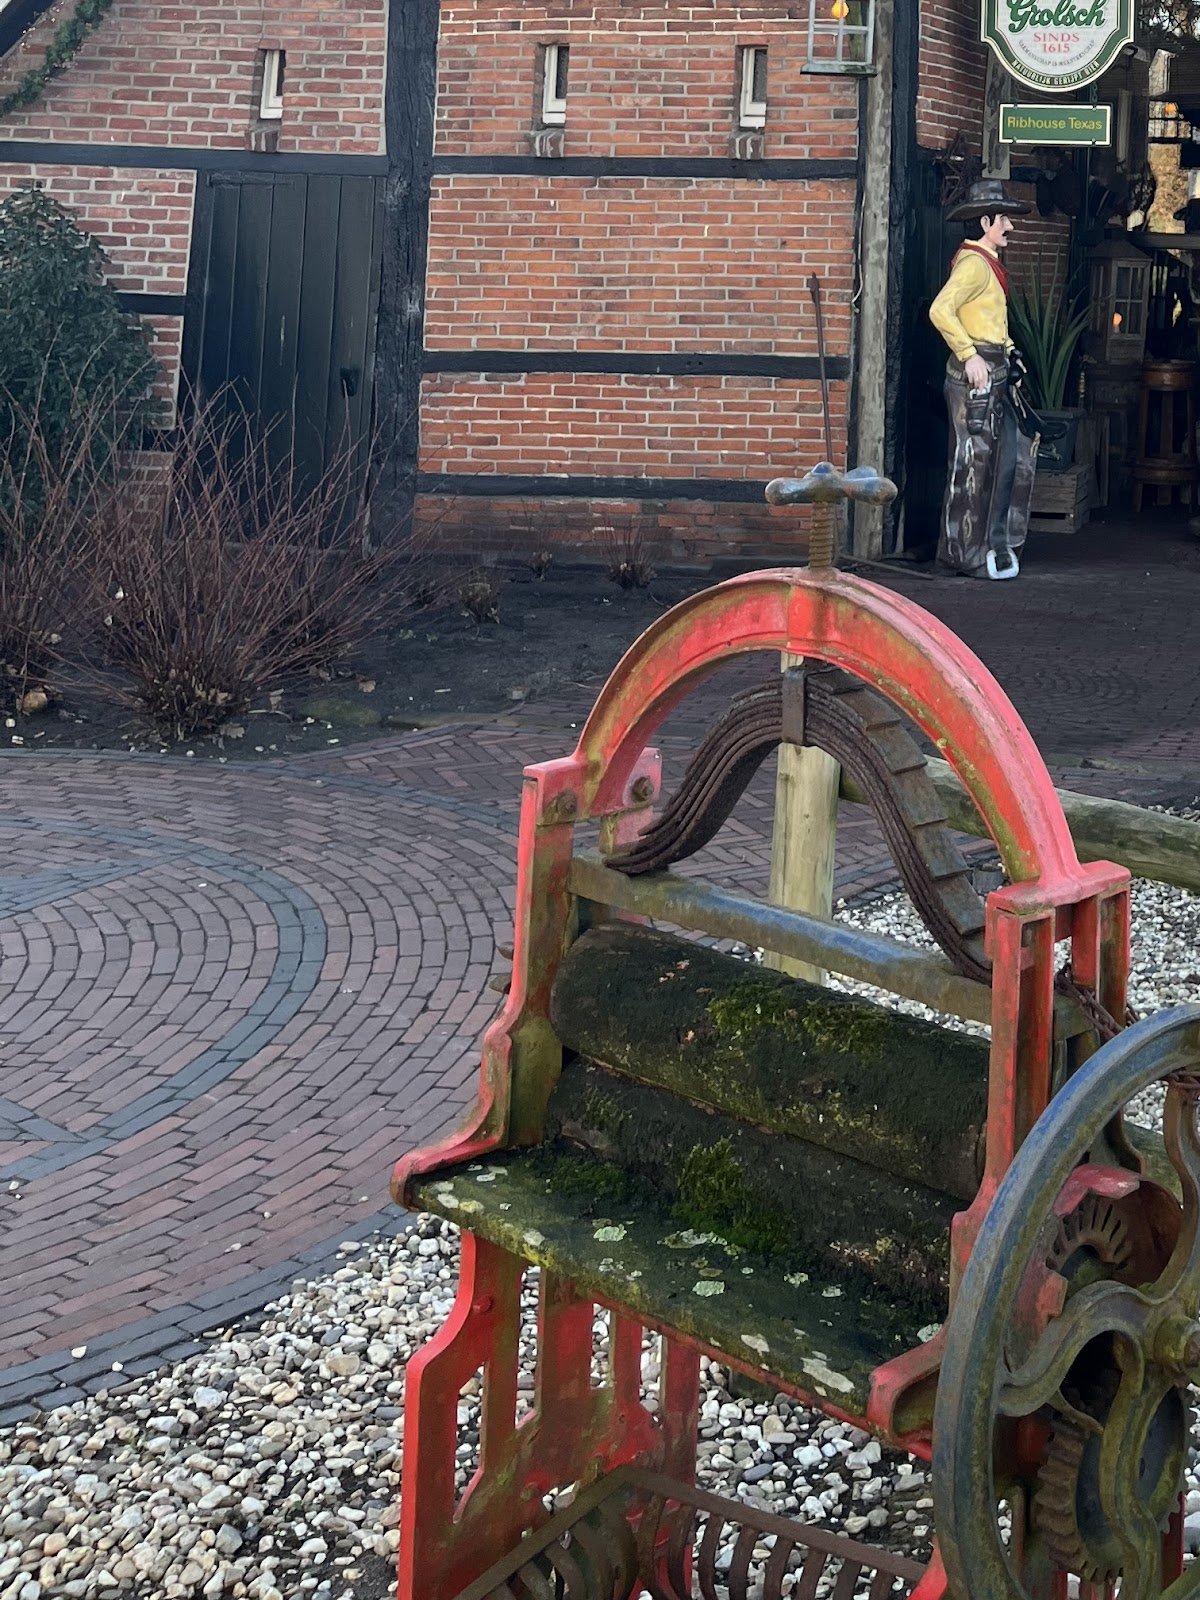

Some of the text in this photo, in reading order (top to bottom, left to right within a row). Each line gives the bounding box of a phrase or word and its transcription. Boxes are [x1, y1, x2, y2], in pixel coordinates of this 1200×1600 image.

[1033, 32, 1080, 42] SINDS
[1042, 43, 1070, 53] 1615
[1012, 59, 1100, 86] NATUURLIJK GERIJPT BIER
[1007, 116, 1103, 130] Ribhouse Texas
